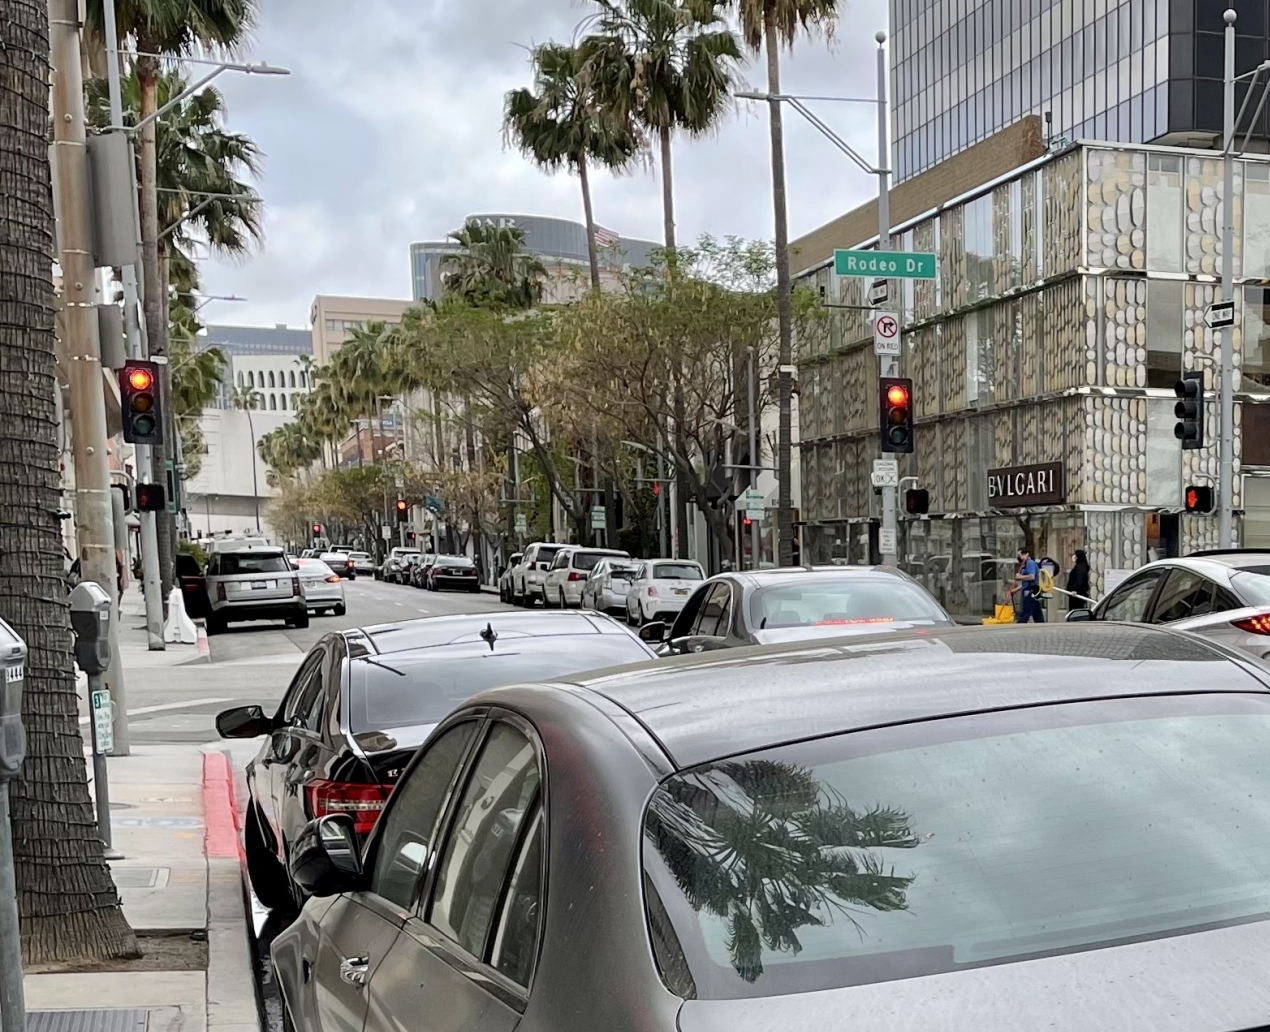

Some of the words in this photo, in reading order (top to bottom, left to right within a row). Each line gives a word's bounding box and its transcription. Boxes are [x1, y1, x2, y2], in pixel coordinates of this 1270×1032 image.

[847, 256, 897, 272] Rodeo
[906, 259, 924, 273] Dr
[876, 342, 885, 350] ON
[886, 342, 898, 351] RED
[988, 469, 1053, 498] BVLGARI
